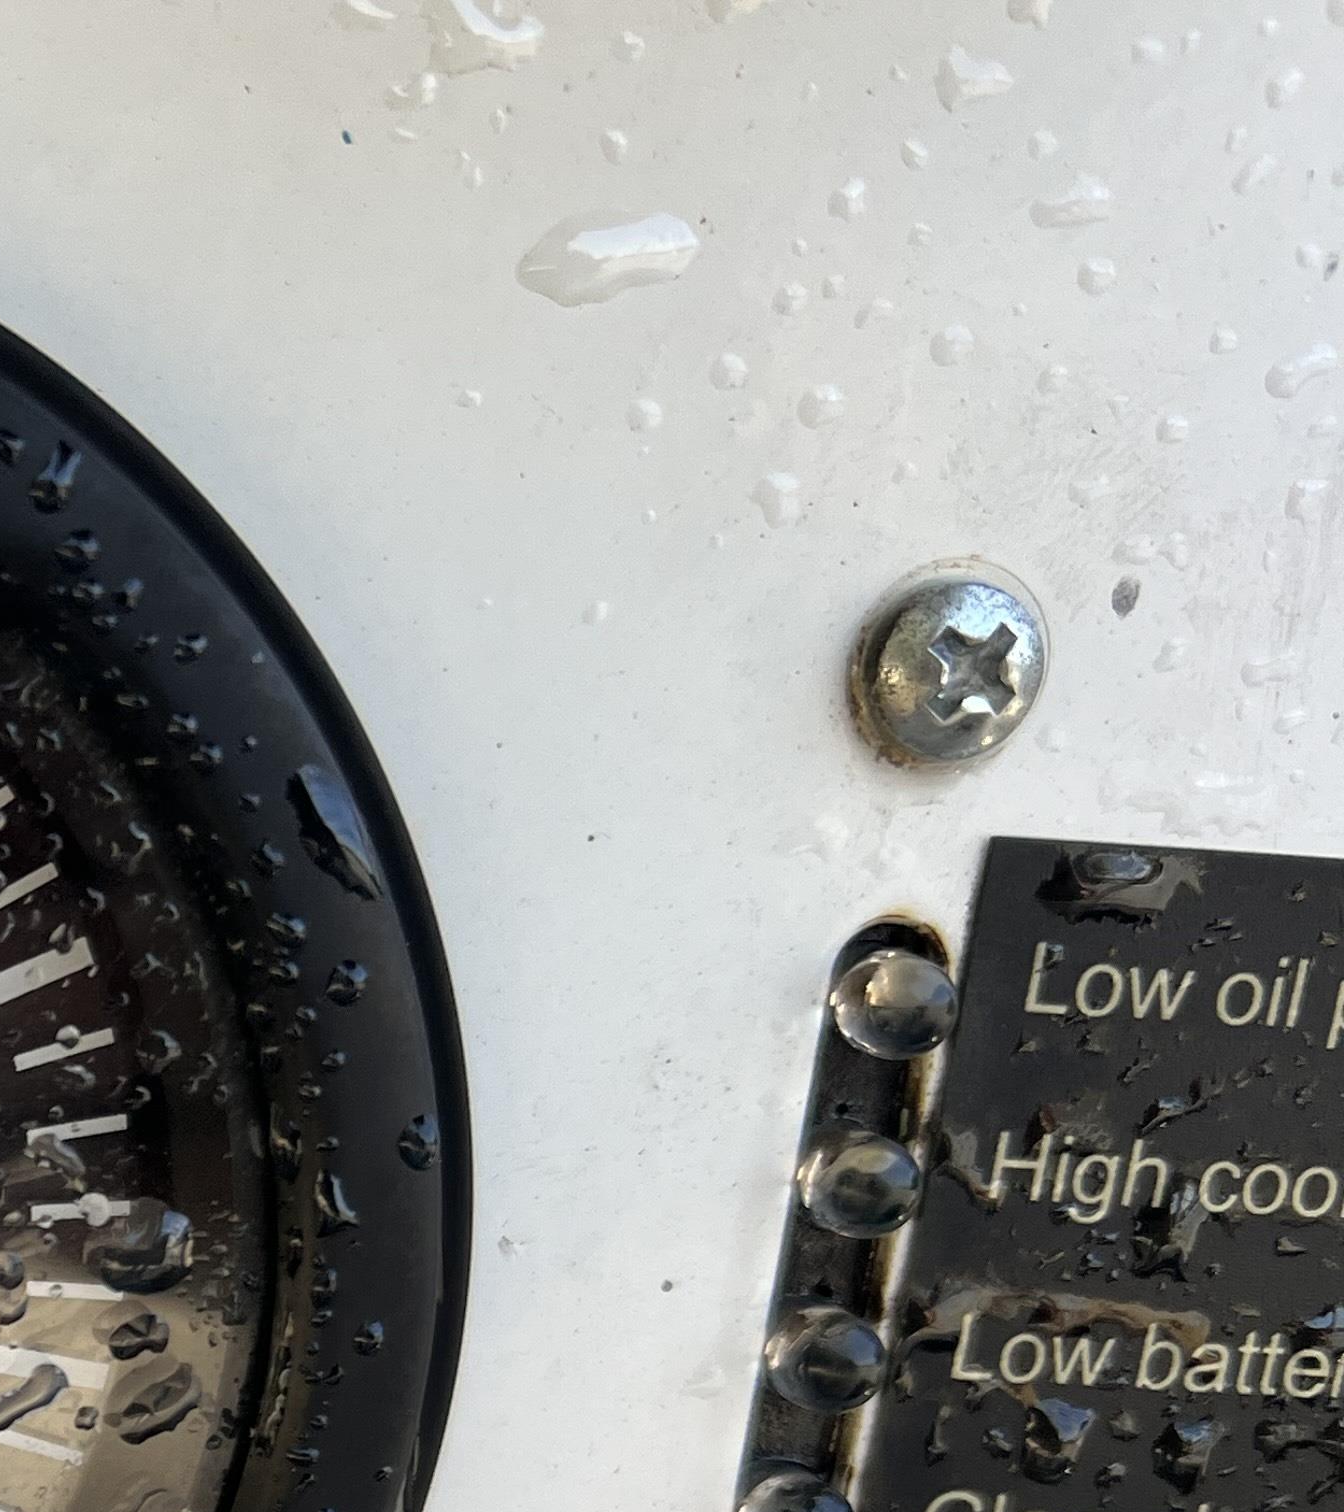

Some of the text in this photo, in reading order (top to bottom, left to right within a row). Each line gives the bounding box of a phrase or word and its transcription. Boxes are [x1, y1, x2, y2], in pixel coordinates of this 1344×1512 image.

[1023, 941, 1196, 1021] Low
[1216, 956, 1311, 1028] oil
[987, 1131, 1344, 1224] High coo
[950, 1311, 1116, 1386] Low
